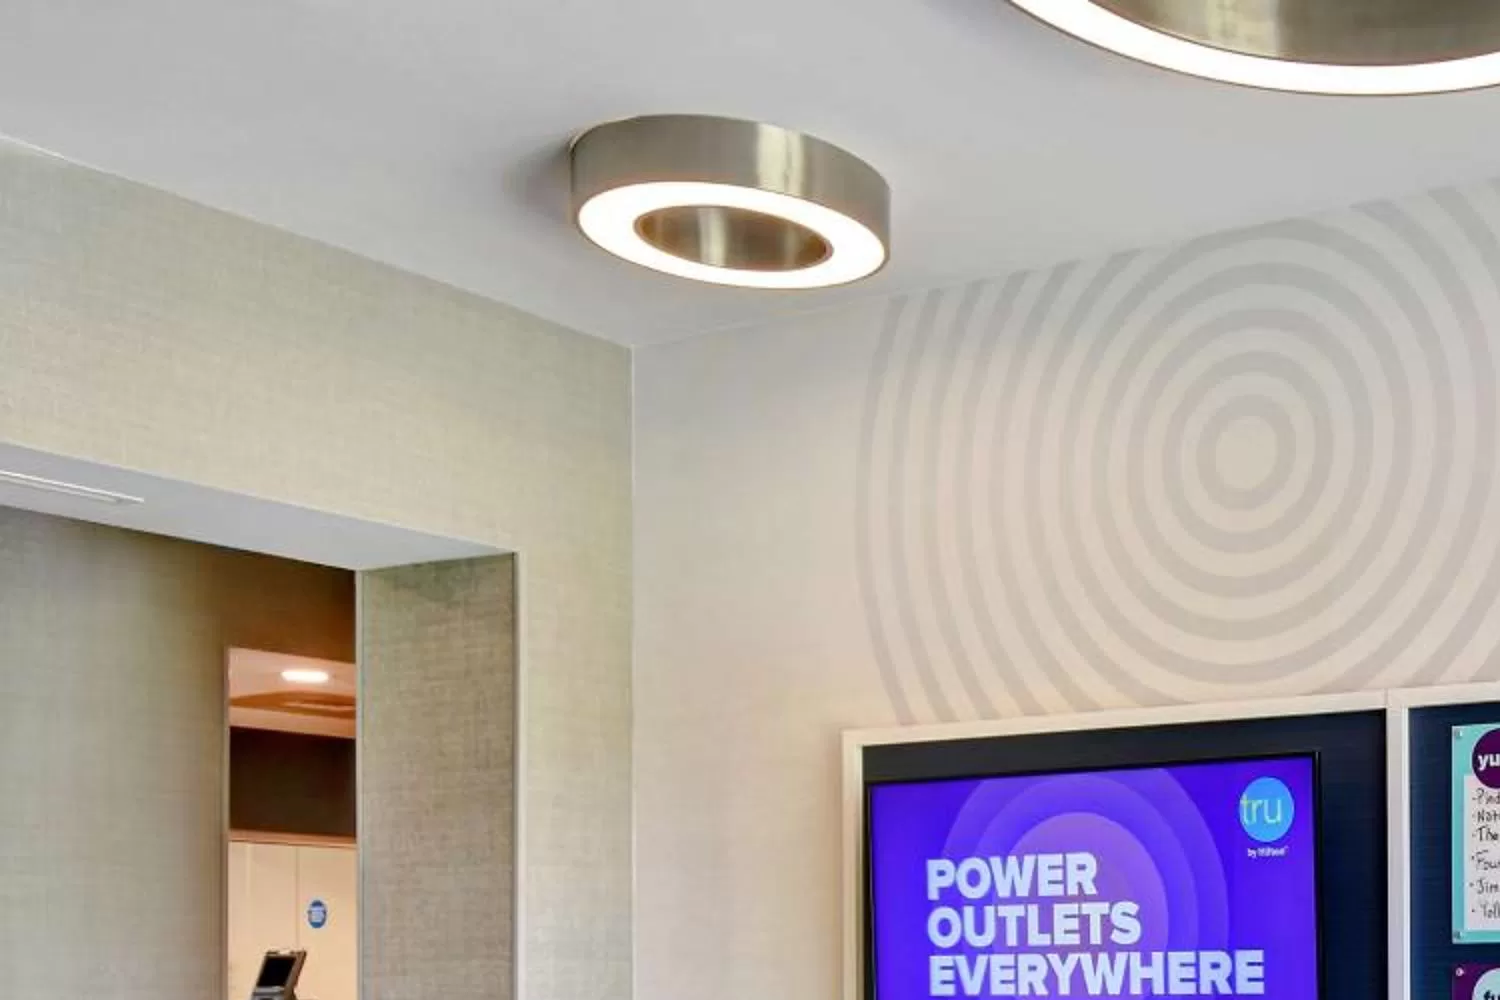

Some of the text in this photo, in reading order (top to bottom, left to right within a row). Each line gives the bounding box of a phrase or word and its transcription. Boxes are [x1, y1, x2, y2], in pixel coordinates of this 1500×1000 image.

[1240, 793, 1283, 824] tru
[1477, 827, 1499, 842] The
[927, 852, 1098, 900] POWER
[927, 901, 1142, 948] OUTLETS
[929, 949, 1265, 996] EVERYWHERE
